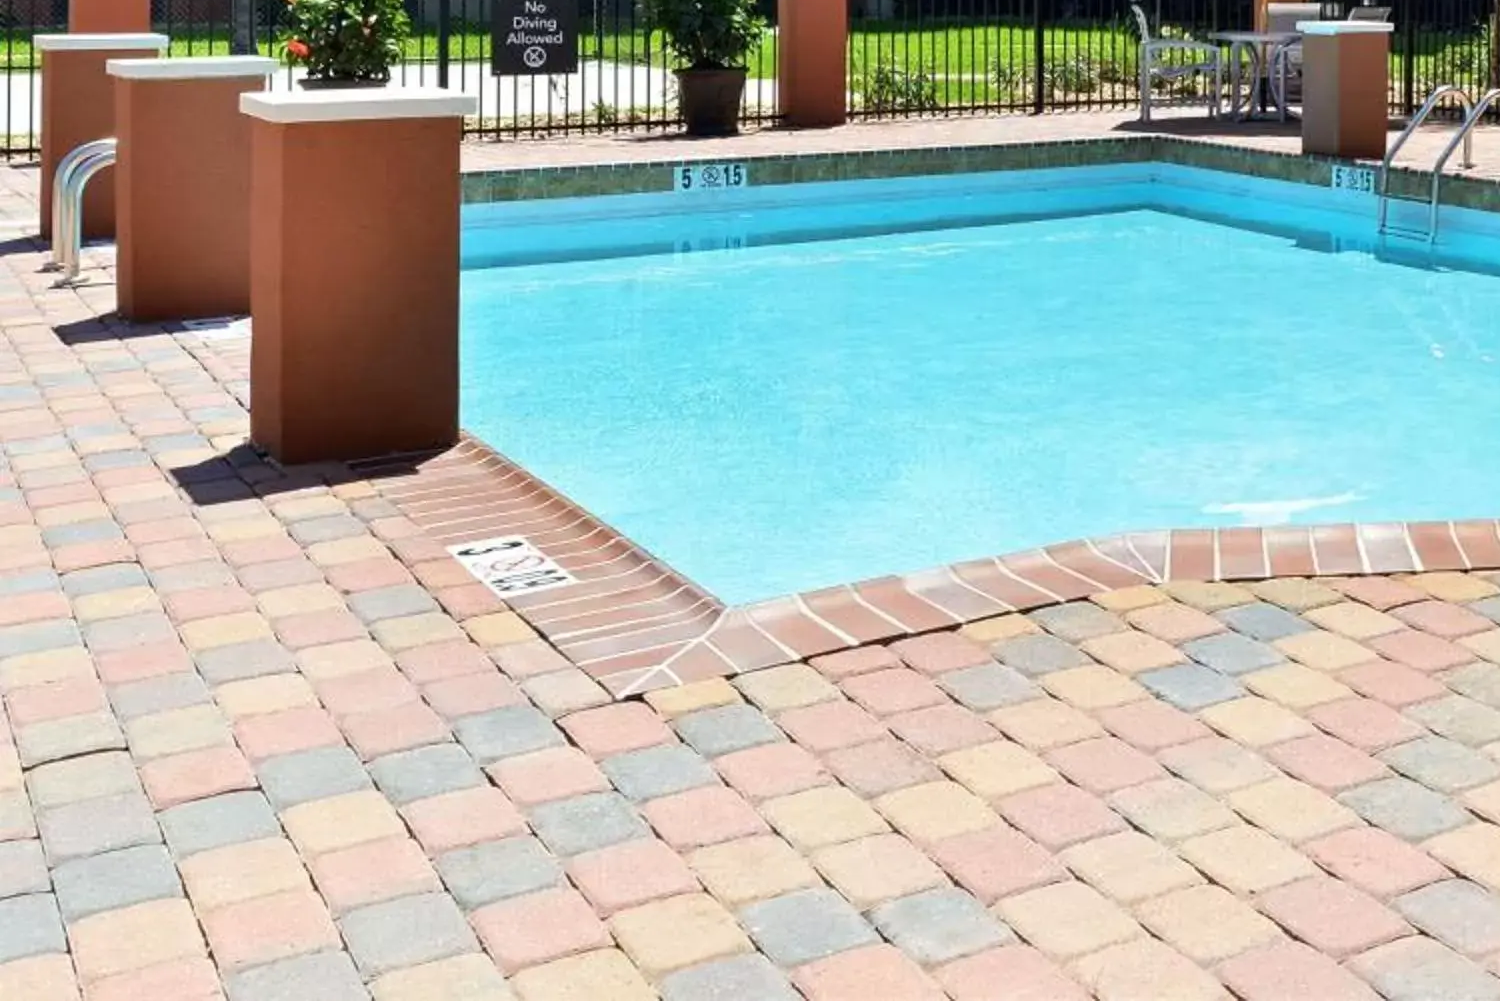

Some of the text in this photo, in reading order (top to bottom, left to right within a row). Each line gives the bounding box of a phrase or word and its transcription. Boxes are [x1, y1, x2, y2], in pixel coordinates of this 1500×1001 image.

[525, 0, 547, 13] No
[513, 16, 557, 31] Diving
[506, 30, 563, 46] Allowed
[682, 168, 692, 189] 5
